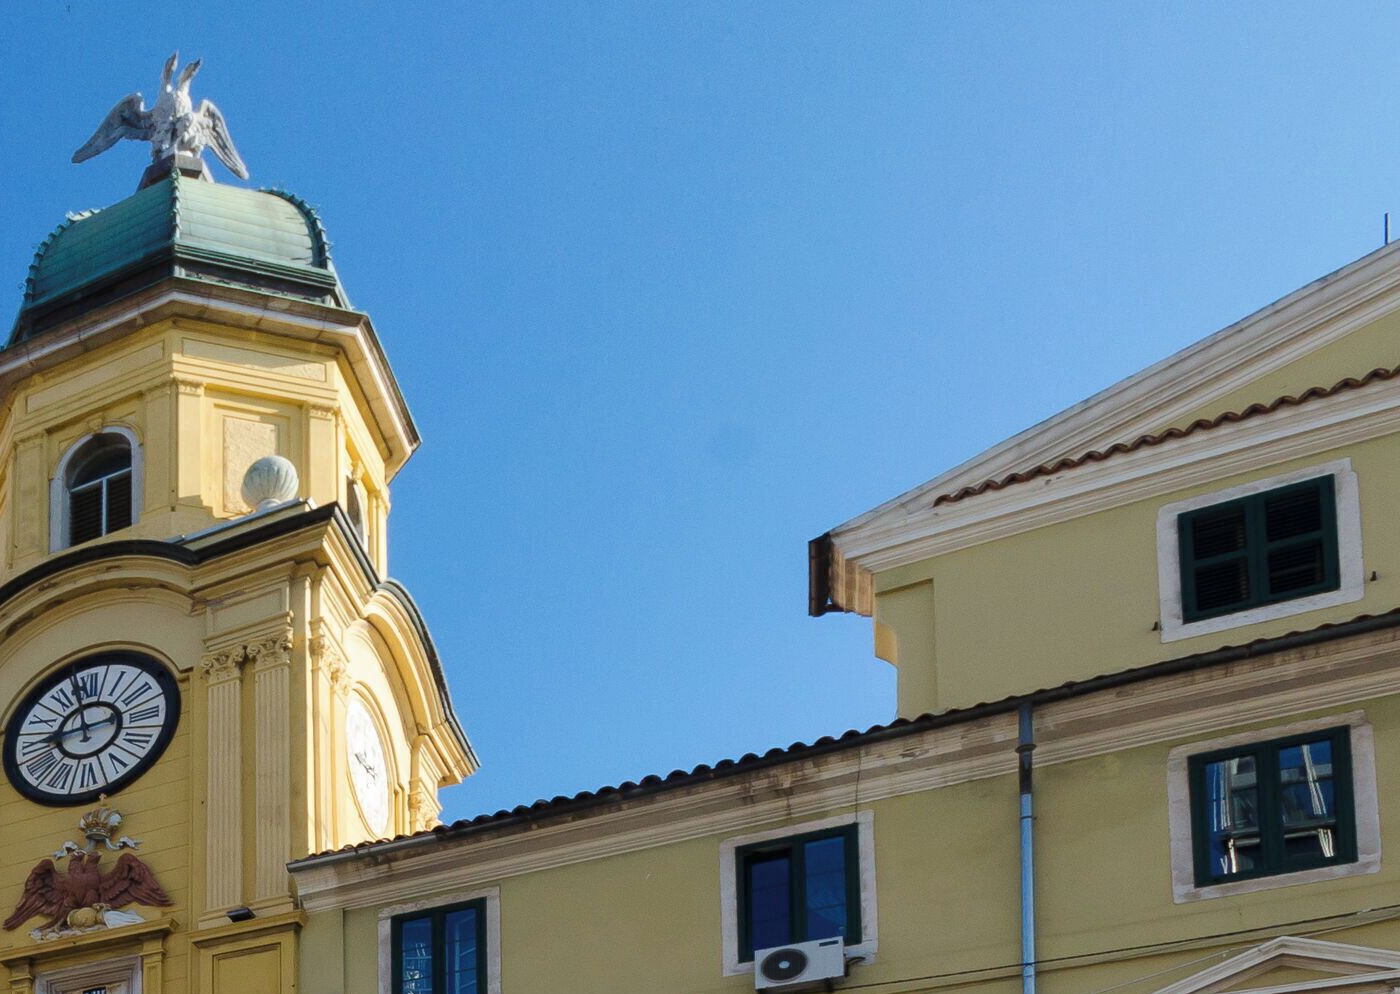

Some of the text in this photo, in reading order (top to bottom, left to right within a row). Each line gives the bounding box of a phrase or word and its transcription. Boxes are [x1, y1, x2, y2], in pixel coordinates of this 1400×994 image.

[51, 688, 73, 711] XI
[122, 682, 152, 706] II
[30, 715, 57, 728] X
[130, 705, 159, 723] III
